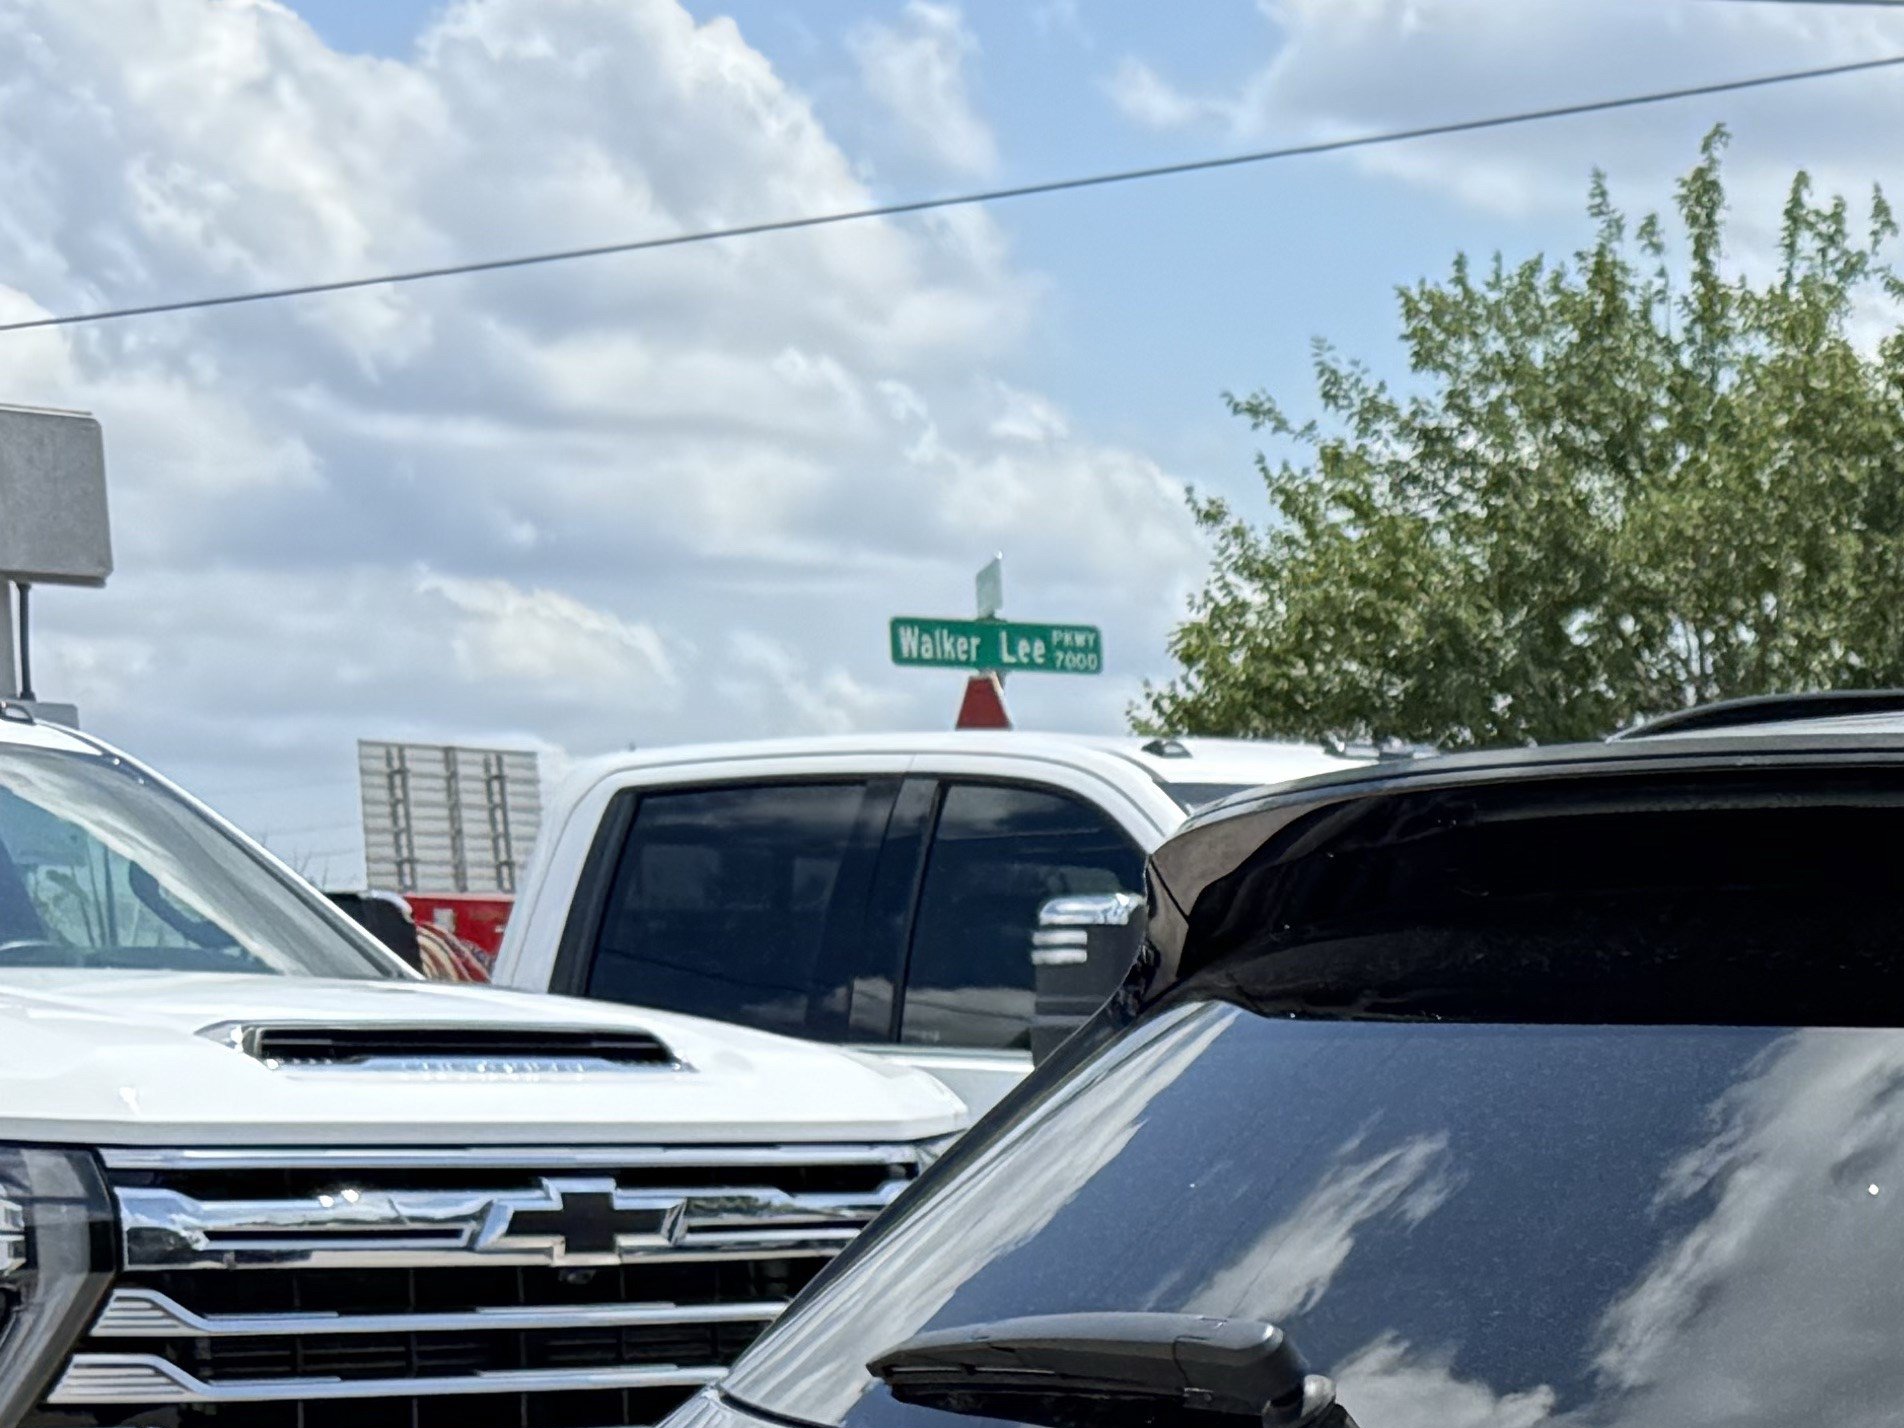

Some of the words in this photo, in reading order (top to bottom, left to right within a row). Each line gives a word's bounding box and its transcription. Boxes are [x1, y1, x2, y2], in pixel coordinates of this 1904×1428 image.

[899, 625, 981, 661] Walker
[1000, 631, 1046, 665] Lee
[1051, 630, 1096, 649] PKWY
